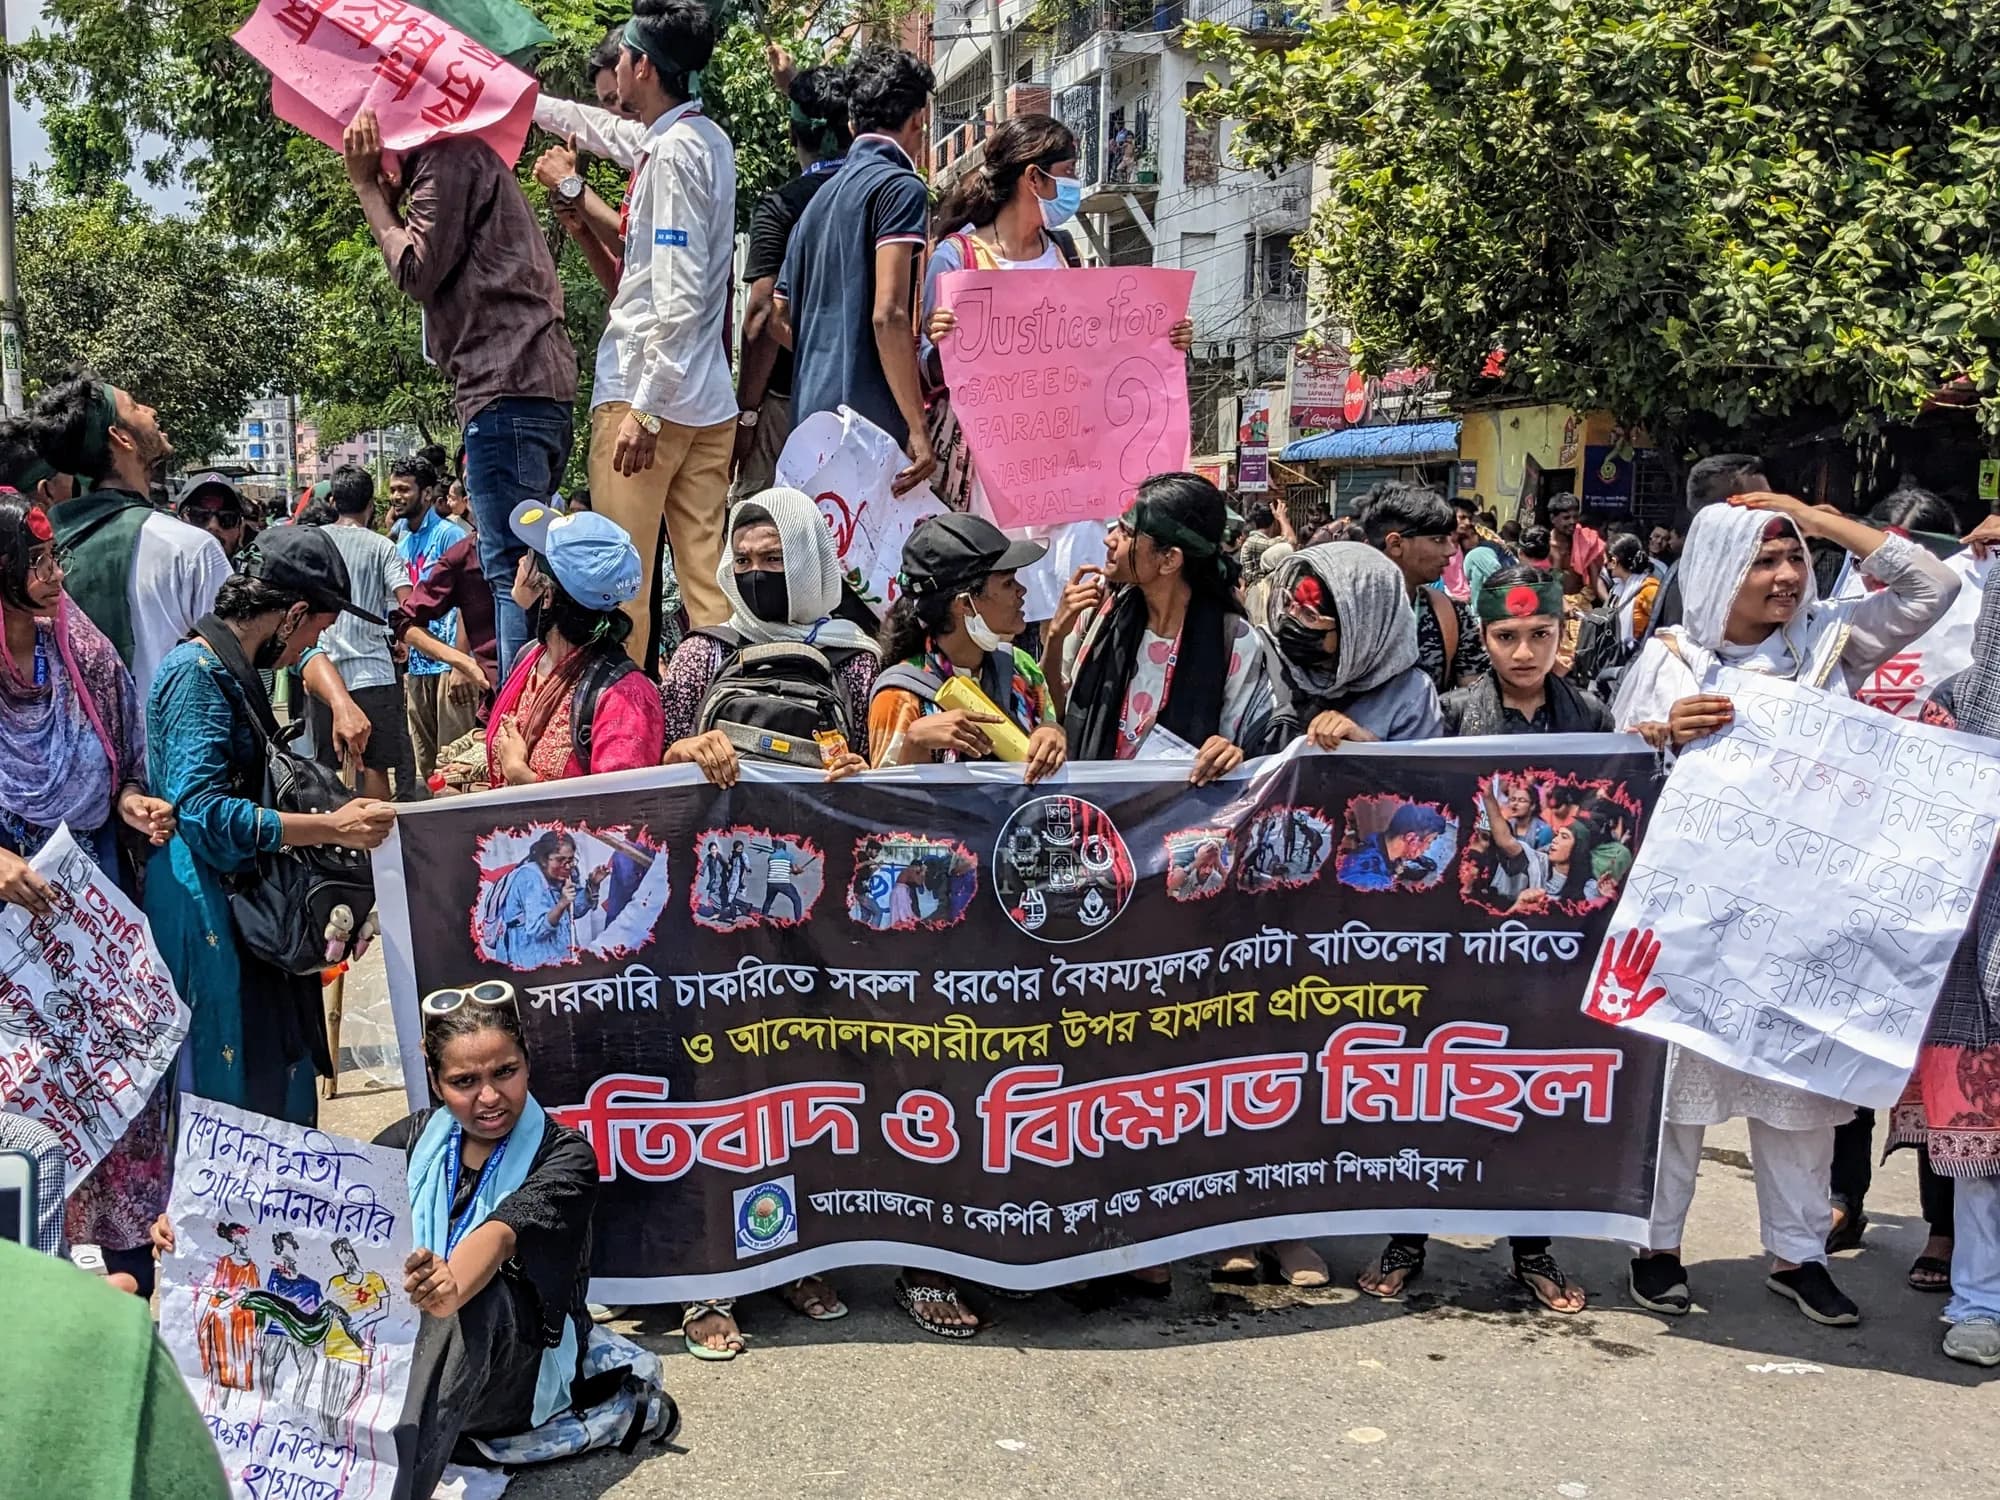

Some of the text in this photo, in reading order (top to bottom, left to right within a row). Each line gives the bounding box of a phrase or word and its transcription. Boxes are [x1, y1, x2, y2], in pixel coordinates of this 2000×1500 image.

[951, 275, 1168, 363] Justice for
[525, 920, 1584, 1016] সরকারি চাকরিতে সকল ধরণের বৈষম্যমূলক কোটা বাতিলের দাবিতে
[681, 975, 1429, 1063] ও আন্দোলনকারীদের উপর হামলার প্রতিবাদে
[548, 1020, 1624, 1182] তিবাদ ও বিক্ষোভ মিছিল
[808, 1188, 935, 1222] আয়োজনে
[960, 1200, 1054, 1236] কেপিবি
[1057, 1197, 1099, 1236] স্কুল
[1146, 1168, 1239, 1208] কলেজের
[1245, 1156, 1328, 1190] সাধারণ
[1333, 1149, 1468, 1192] শিক্ষার্থীবৃন্দ
